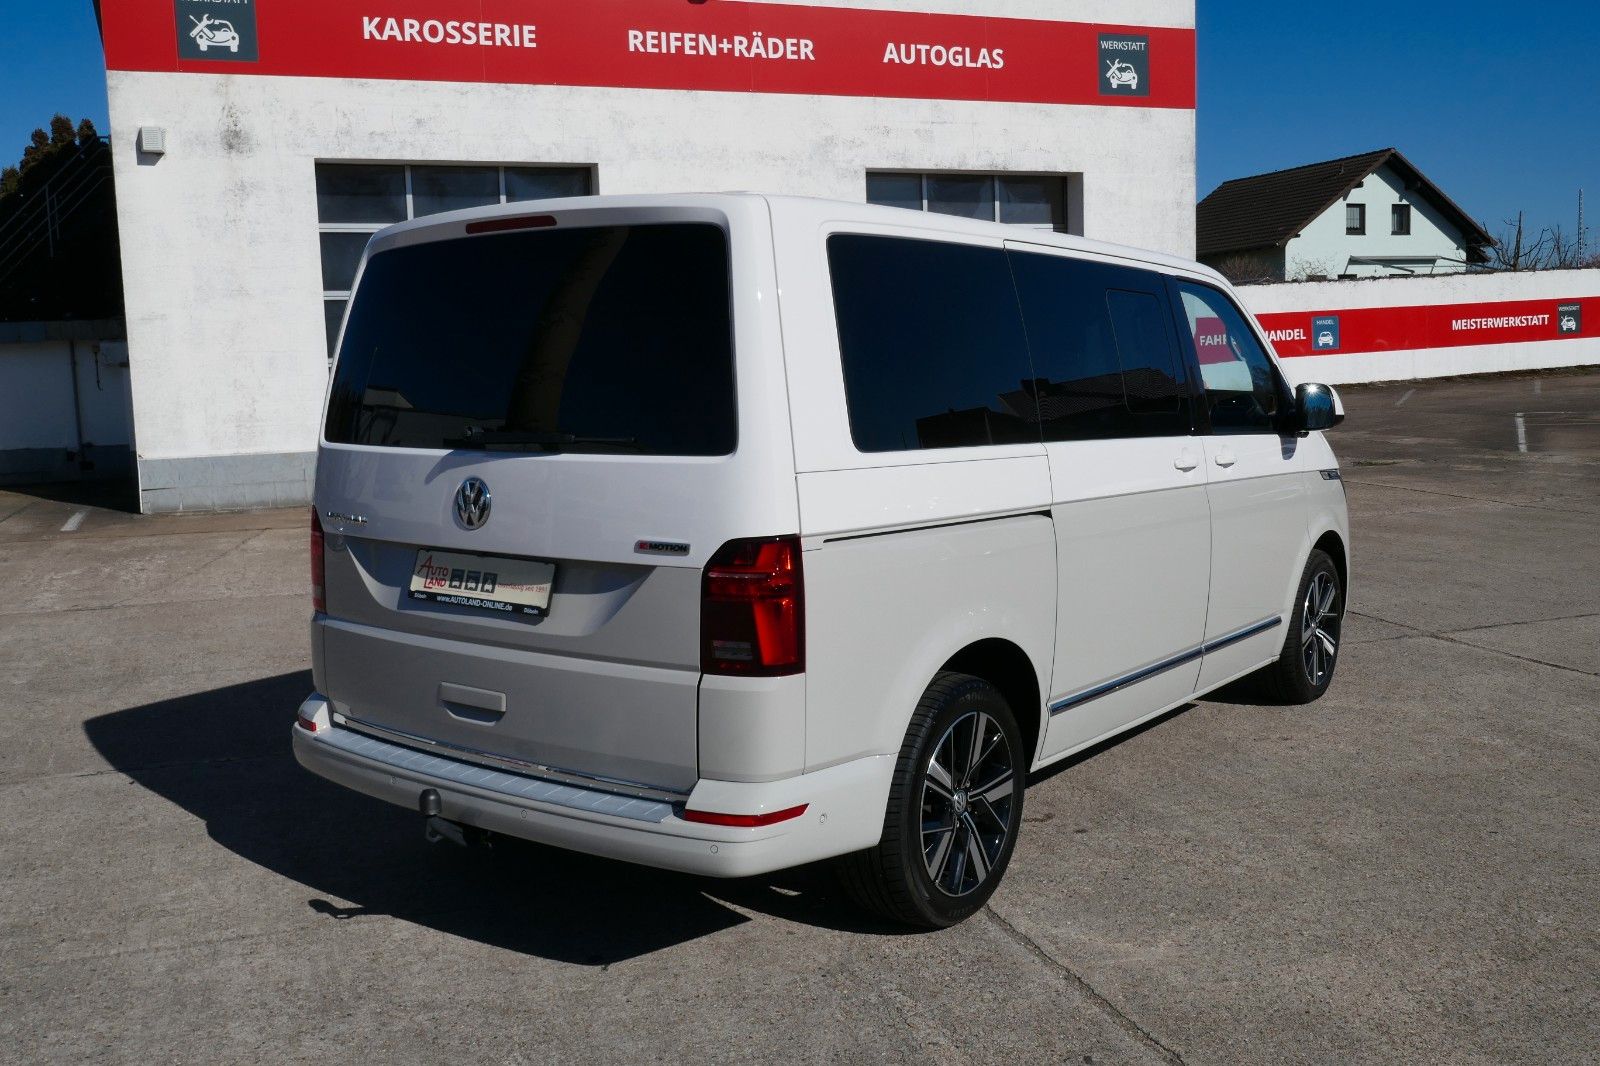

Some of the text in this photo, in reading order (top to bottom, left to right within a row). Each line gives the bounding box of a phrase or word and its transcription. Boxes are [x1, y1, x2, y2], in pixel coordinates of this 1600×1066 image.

[362, 16, 537, 48] KAROSSERIE
[627, 29, 815, 62] REIFEN+RÄDER
[1100, 40, 1146, 51] WERKSTATT
[883, 42, 1005, 70] AUTOGLAS
[1452, 314, 1550, 331] MEISTERWERKSTATT
